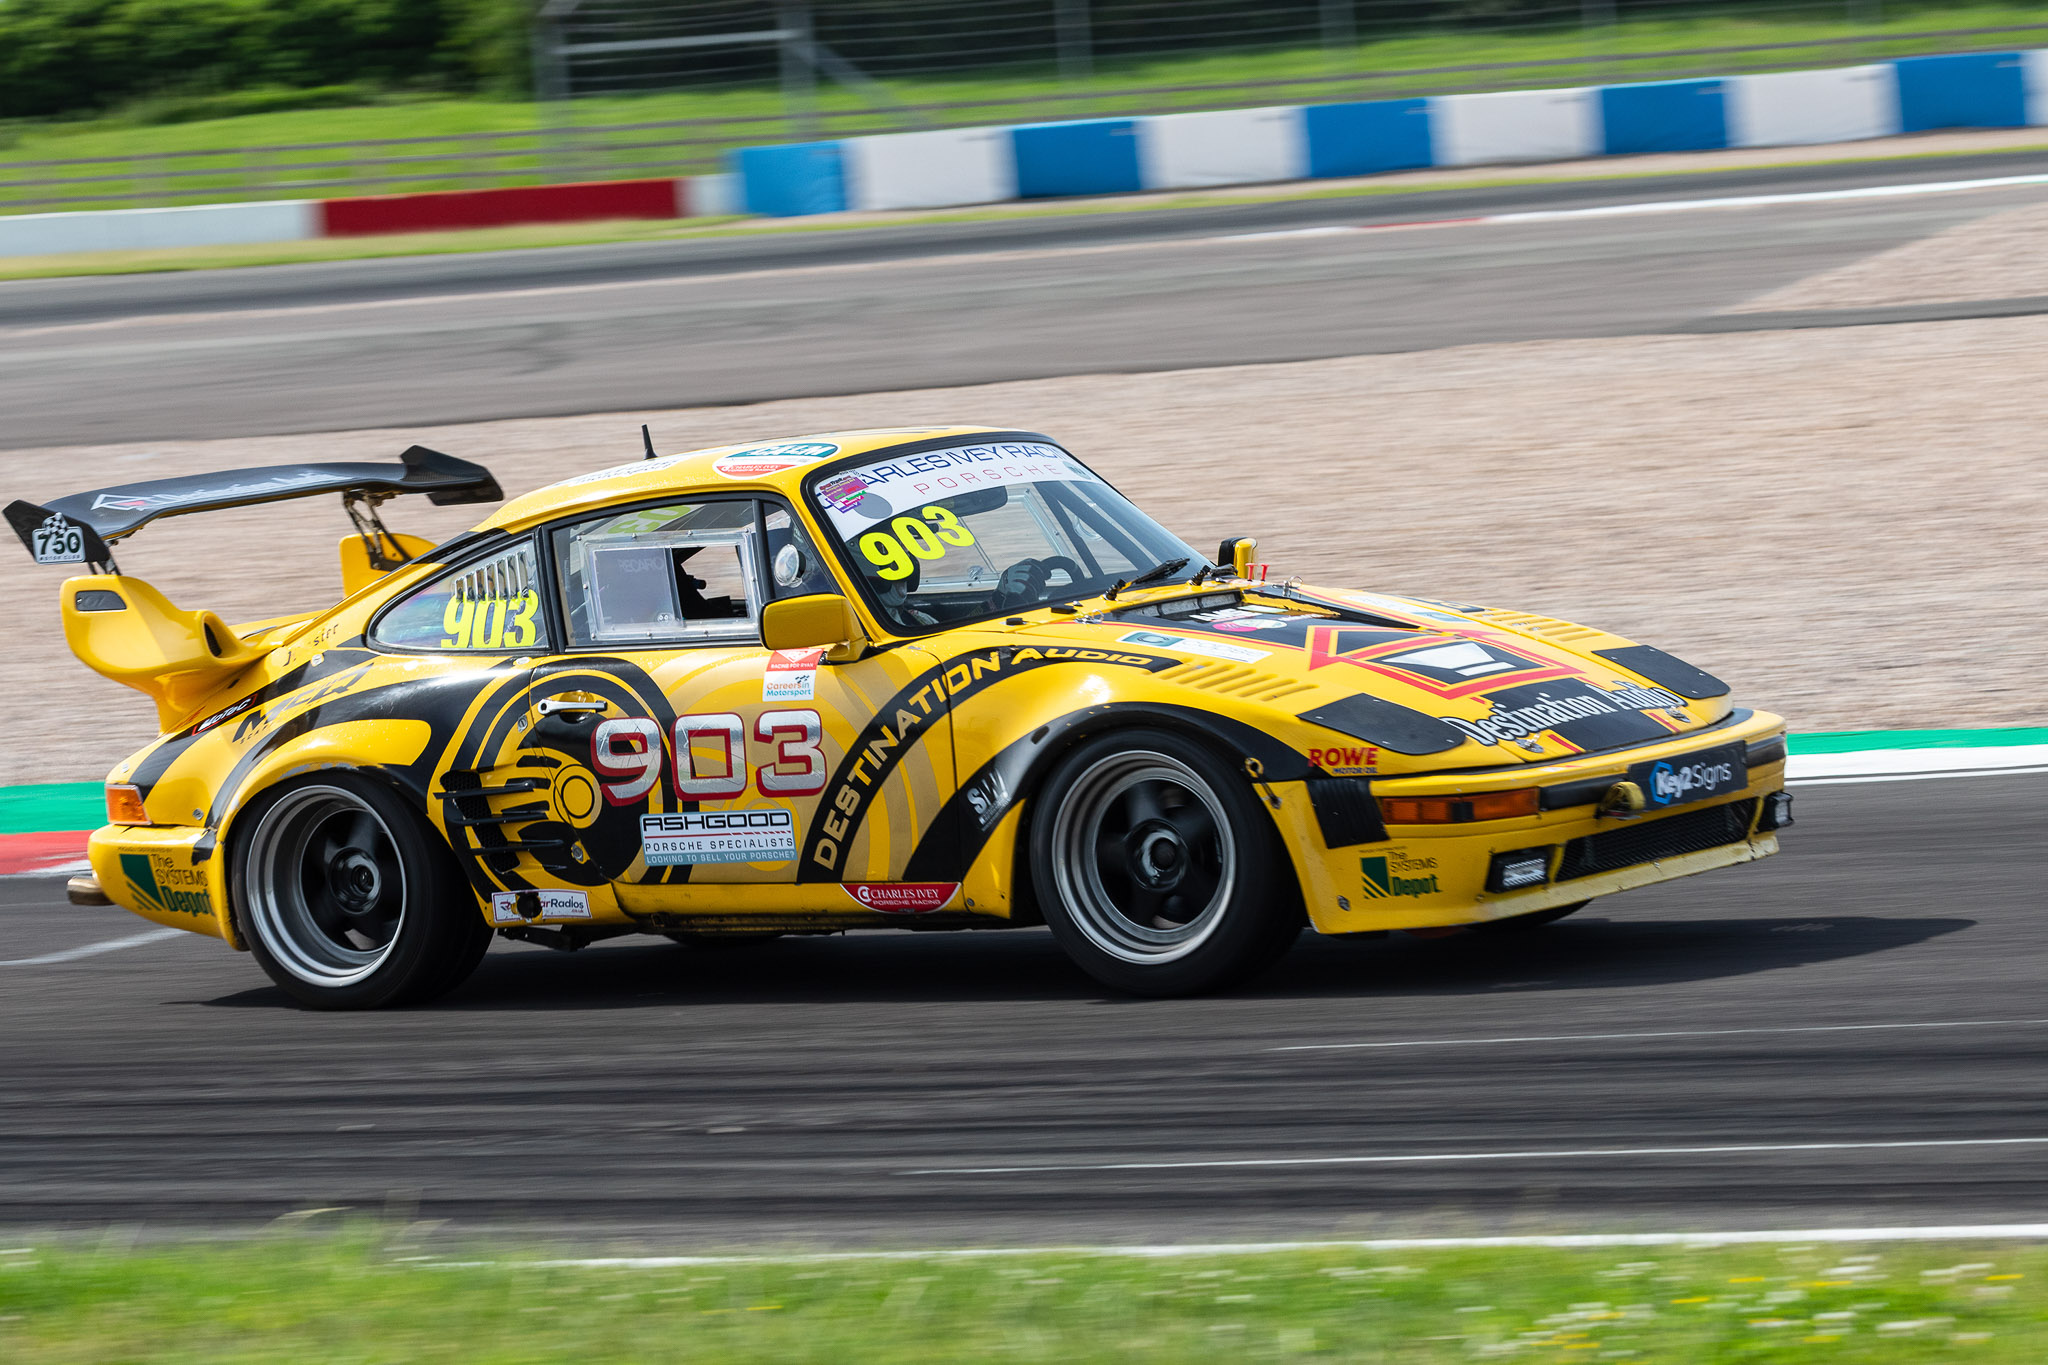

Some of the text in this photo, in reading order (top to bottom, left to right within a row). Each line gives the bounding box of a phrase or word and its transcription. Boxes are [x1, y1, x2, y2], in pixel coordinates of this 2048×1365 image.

[951, 446, 1003, 464] IVEY
[913, 464, 1063, 496] PORSCHE
[38, 532, 81, 555] 750
[859, 506, 975, 581] 903
[441, 589, 539, 648] 903
[766, 689, 811, 697] Motorsport
[1439, 680, 1687, 746] Destination Audio
[591, 708, 828, 807] 903
[813, 647, 1153, 870] DESTINATION AUDIO
[1307, 747, 1379, 767] ROWE
[643, 812, 790, 831] ASHGOOD
[645, 838, 793, 852] PORSCHE SPECIALISTS
[150, 853, 174, 868] The
[646, 850, 795, 864] LOOKING TO SELL YOUR PORSCHE?
[155, 869, 208, 887] SYSTEMS
[870, 889, 939, 899] CHARLES IVEY
